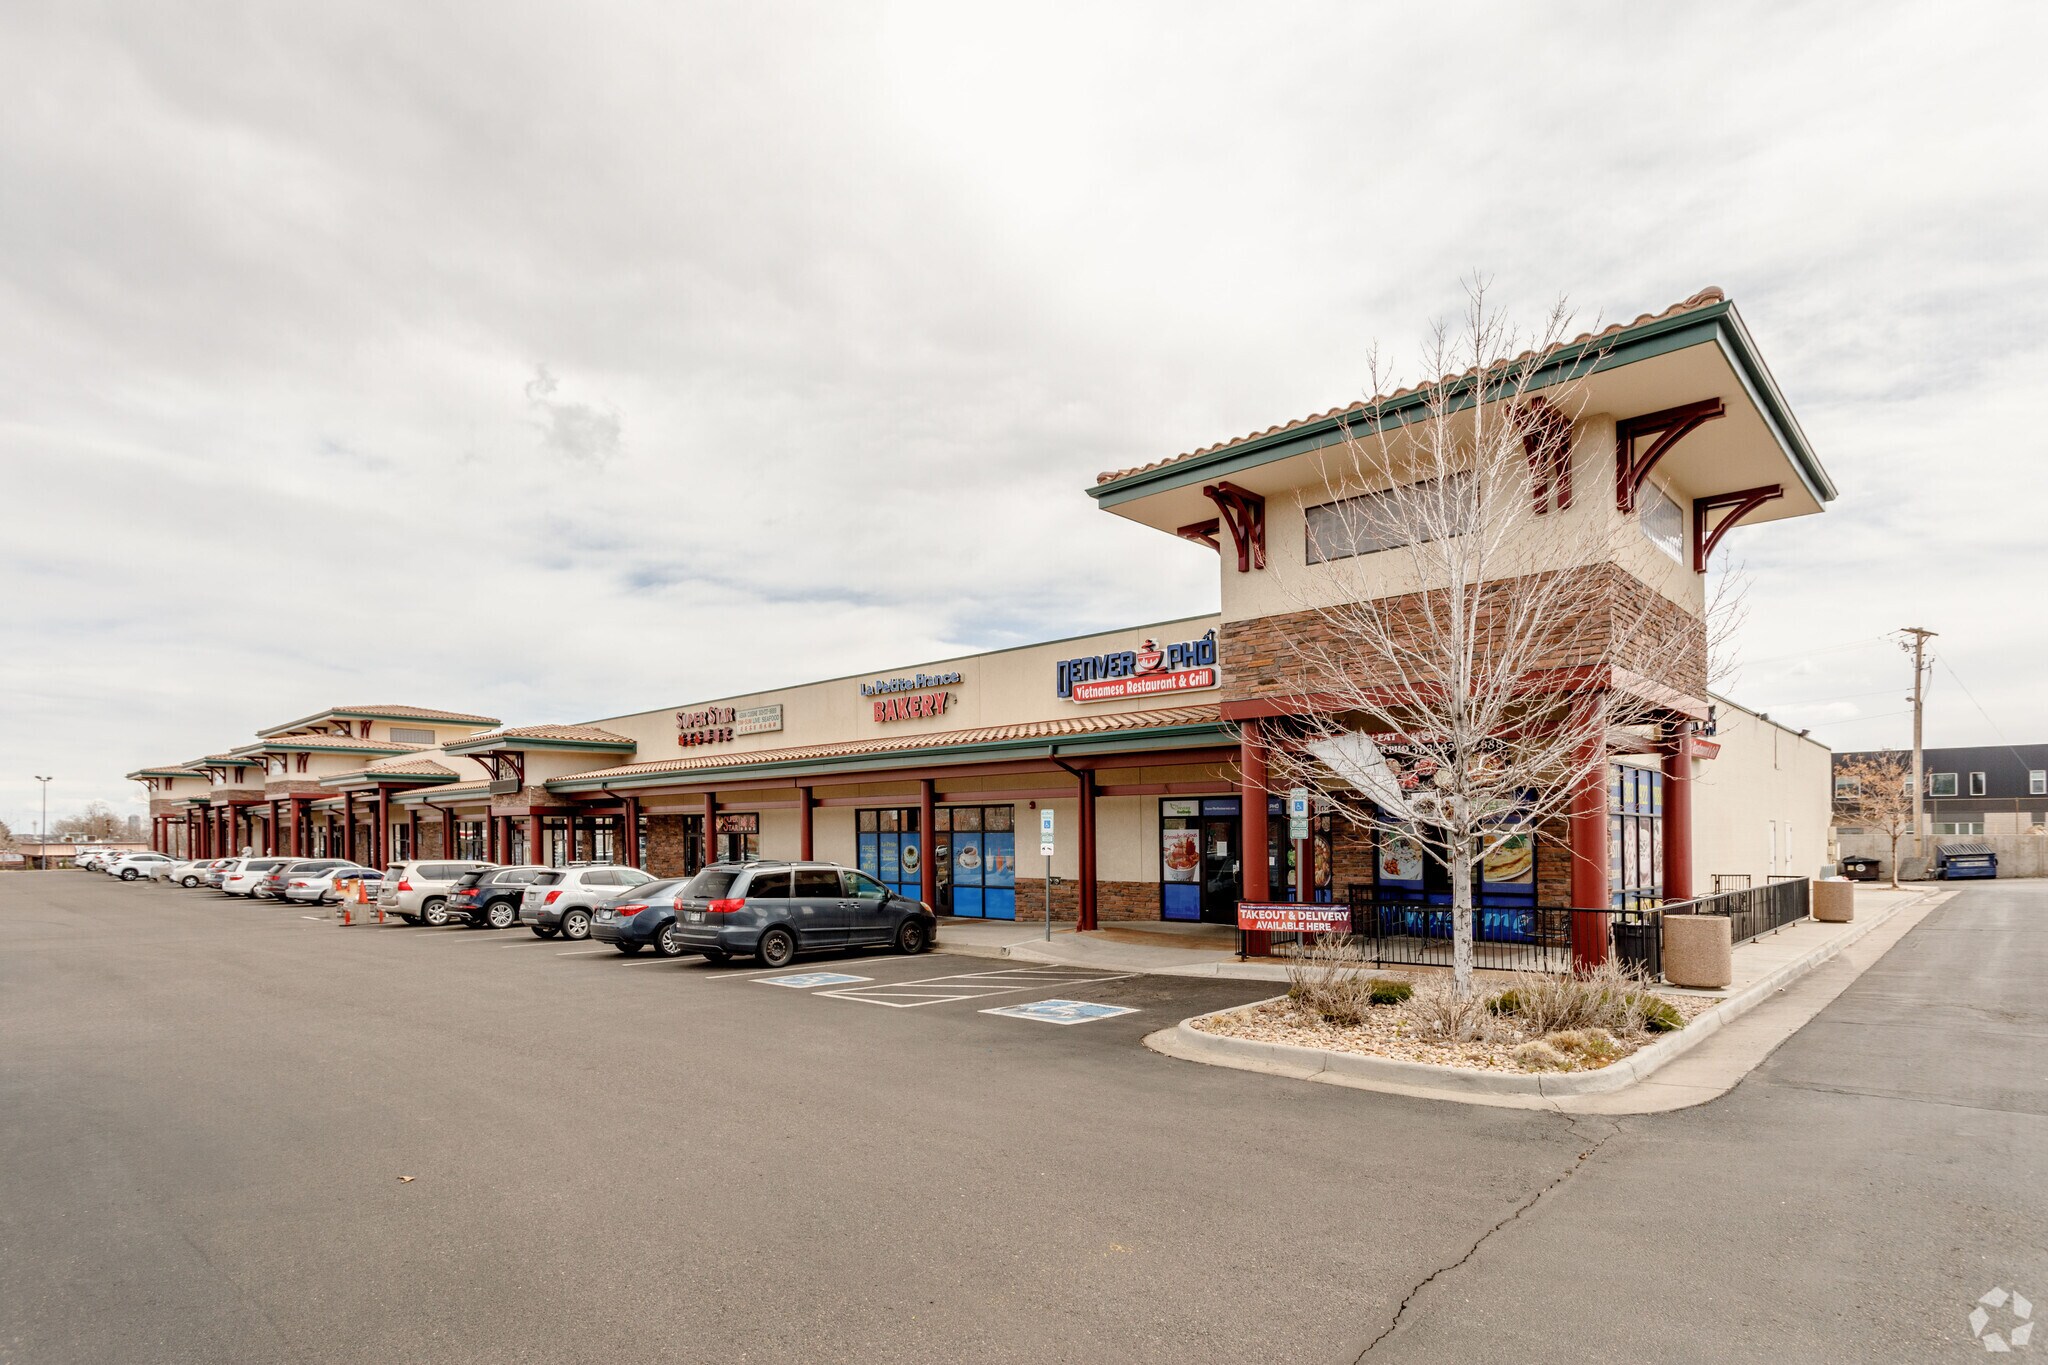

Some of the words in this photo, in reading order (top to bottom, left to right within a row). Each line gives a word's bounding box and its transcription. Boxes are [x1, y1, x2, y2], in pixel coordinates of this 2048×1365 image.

[860, 683, 874, 696] La
[875, 679, 913, 694] Petite
[915, 671, 961, 689] France
[1057, 650, 1136, 698] DENVER
[1076, 678, 1125, 699] Vietnamese
[1126, 676, 1177, 694] Restaurant
[1179, 674, 1187, 687] &
[1189, 671, 1209, 686] Grill
[676, 711, 710, 730] SUPER
[708, 706, 736, 725] STAR
[873, 691, 947, 722] BAKERY
[1240, 909, 1287, 920] TAKEOUT
[1288, 911, 1296, 920] &
[1298, 911, 1349, 921] DELIVERY
[1256, 921, 1304, 930] AVAILABLE
[1306, 922, 1332, 931] HERE
